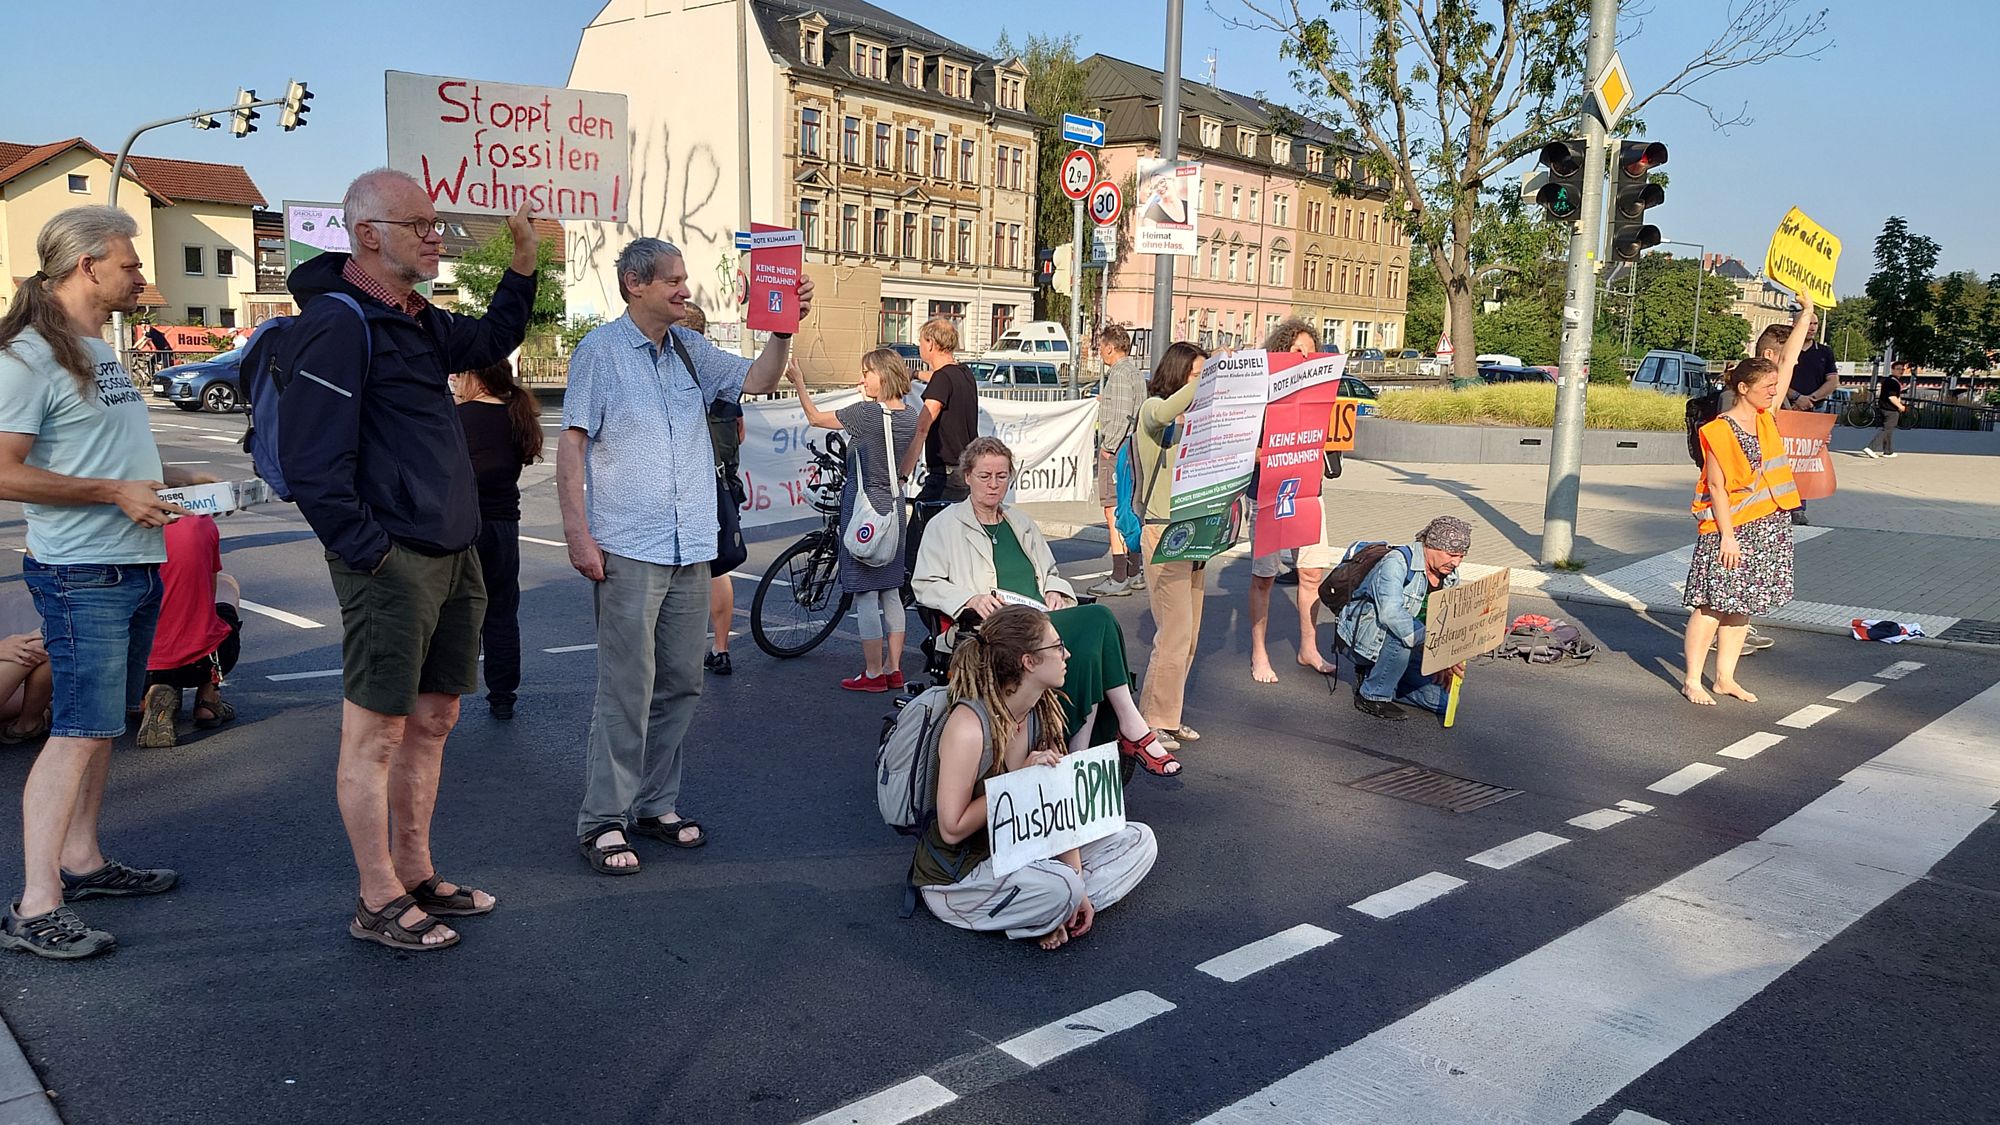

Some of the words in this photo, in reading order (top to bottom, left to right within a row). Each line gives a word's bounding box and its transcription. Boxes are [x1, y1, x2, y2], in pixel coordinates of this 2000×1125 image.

[438, 81, 552, 132] Stoppt
[568, 99, 614, 139] den
[473, 129, 600, 171] fossilen
[1096, 193, 1115, 214] 30
[767, 235, 796, 243] KLIMAKARTE
[1142, 231, 1171, 240] Heimat
[1142, 241, 1162, 249] ohne
[1164, 241, 1184, 250] Hass.
[1800, 230, 1818, 248] auf
[1816, 237, 1833, 260] die
[755, 264, 775, 273] KEINE
[776, 266, 797, 276] NEUEN
[755, 274, 796, 286] AUTOBAHNEN
[1773, 248, 1832, 299] WISSENSCHAFT
[1217, 357, 1264, 370] OULSPIEL!
[1273, 377, 1289, 393] ROTE
[1290, 364, 1334, 386] KLIMAKARTE
[1326, 402, 1356, 443] LS
[1268, 432, 1295, 448] KEINE
[1296, 429, 1323, 444] NEUEN
[1266, 449, 1319, 468] AUTOBAHNEN
[992, 783, 1076, 855] Ausbau
